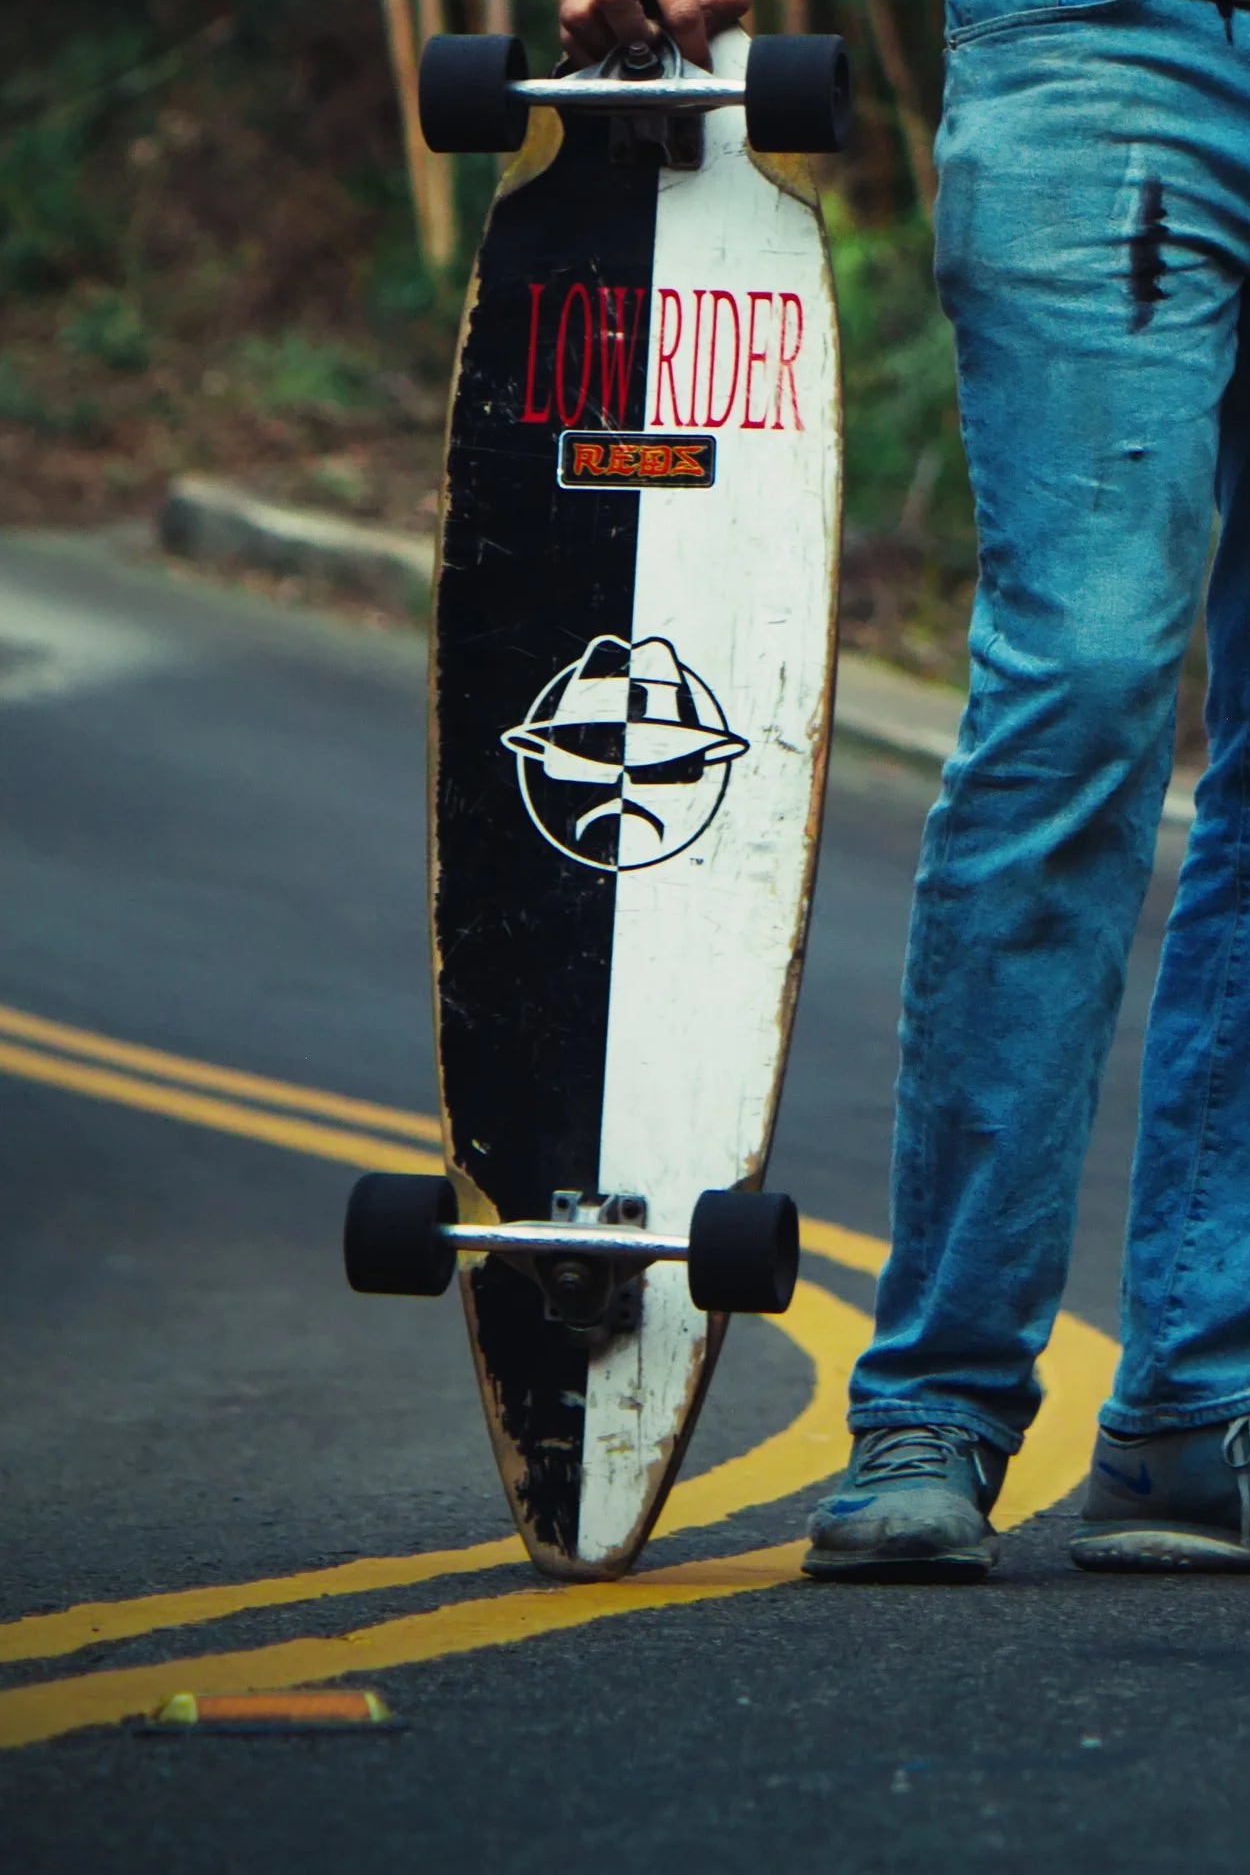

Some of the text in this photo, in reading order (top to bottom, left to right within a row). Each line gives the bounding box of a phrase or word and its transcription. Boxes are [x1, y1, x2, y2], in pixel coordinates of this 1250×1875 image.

[520, 283, 806, 431] LOW RIDER
[573, 443, 707, 477] REDS
